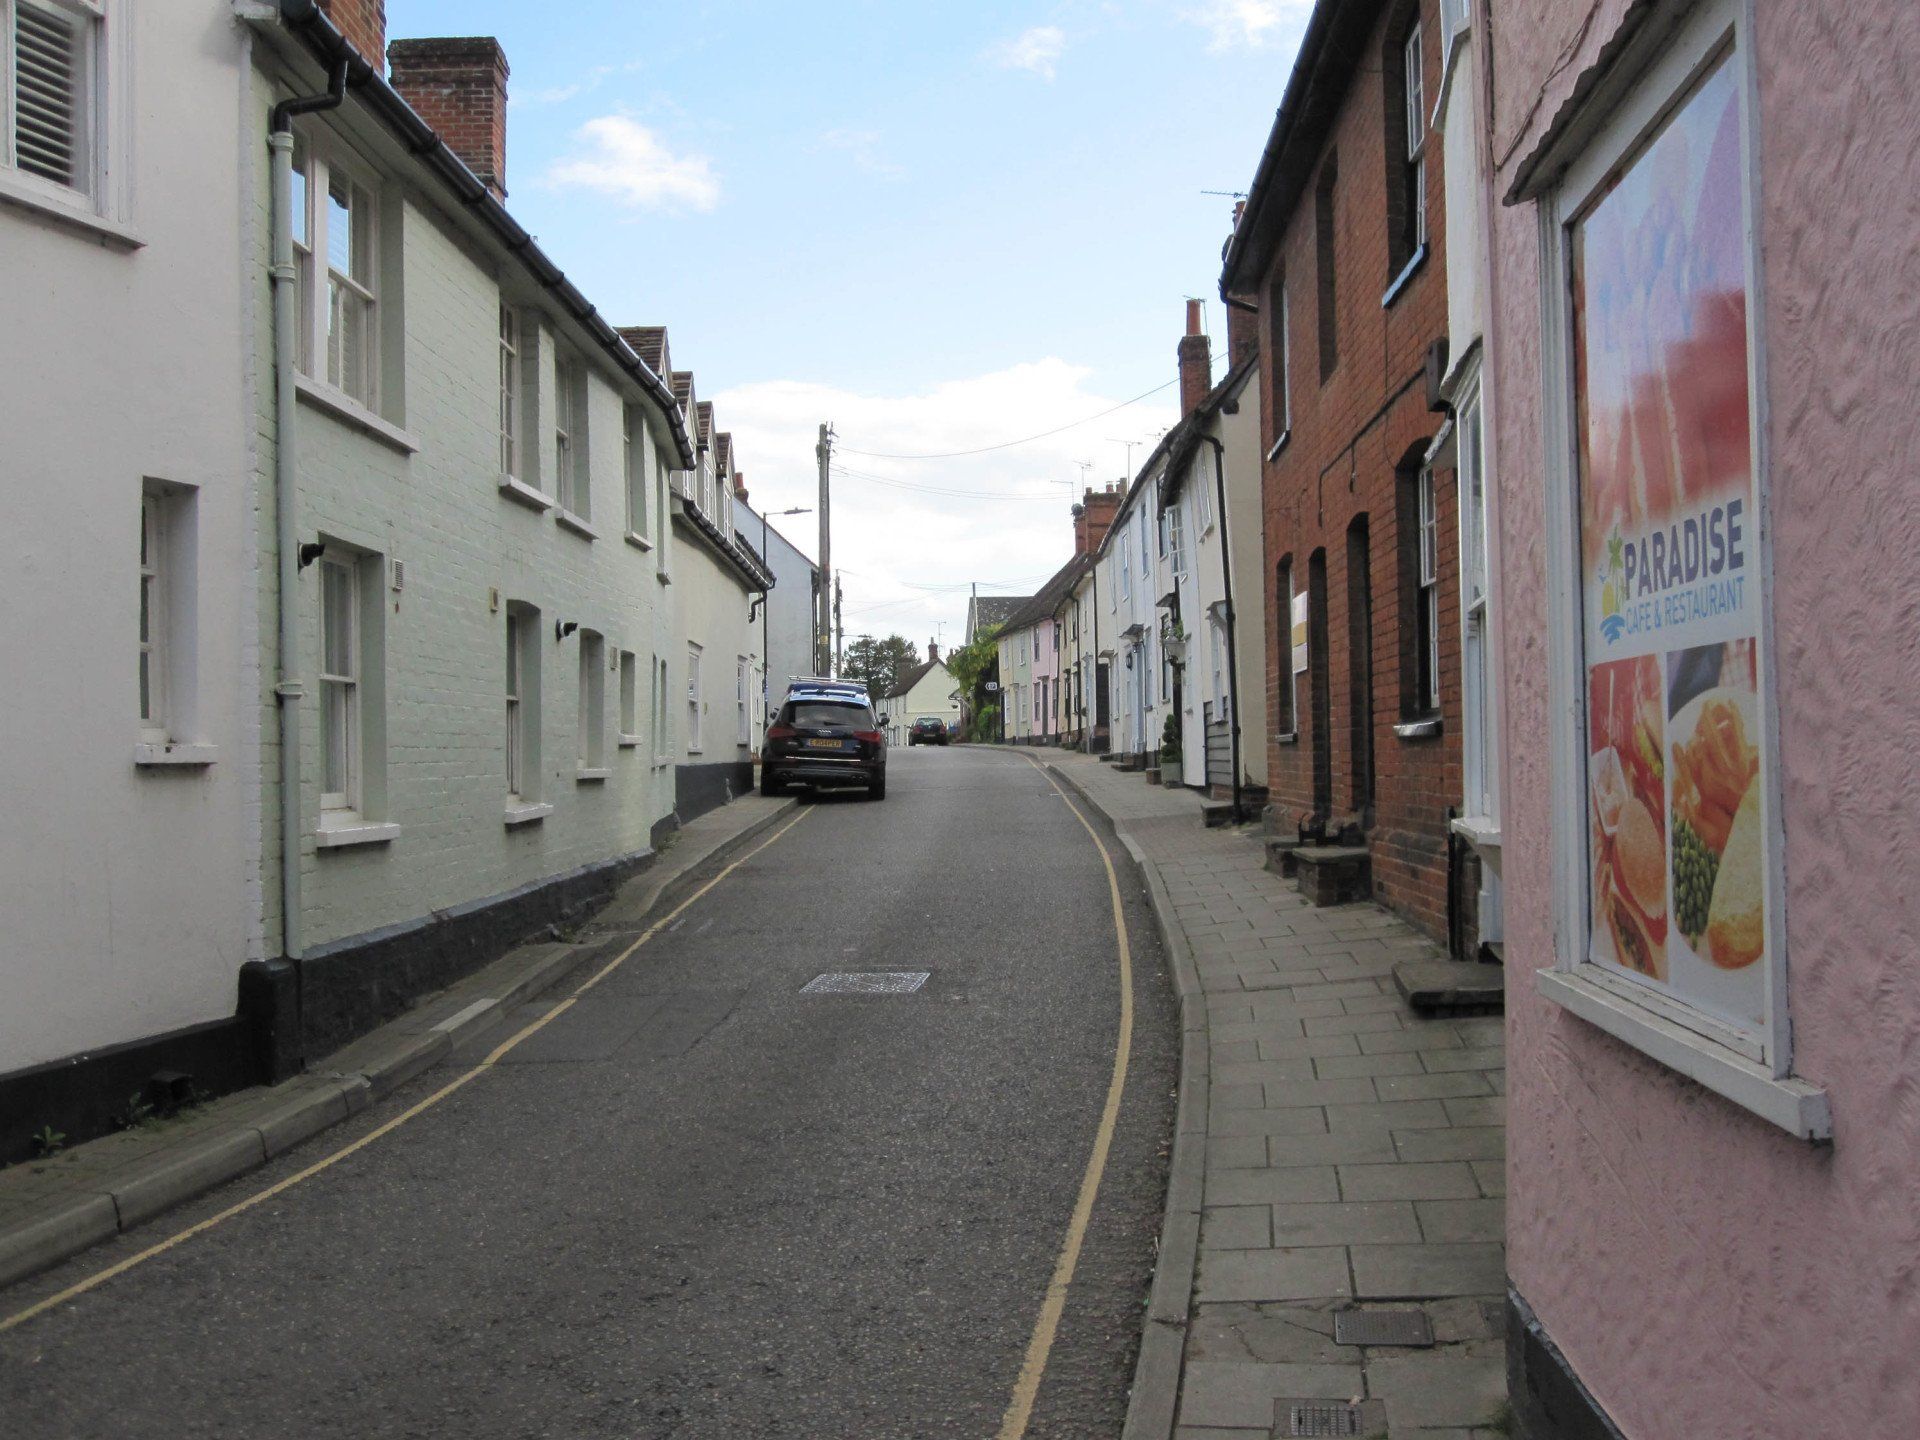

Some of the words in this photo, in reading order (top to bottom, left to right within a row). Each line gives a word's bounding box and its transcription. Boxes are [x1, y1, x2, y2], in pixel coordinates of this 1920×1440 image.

[1624, 498, 1744, 600] PARADISE
[1626, 602, 1651, 635] CAFE
[1654, 600, 1662, 628] &
[1665, 576, 1745, 625] RESTAURANT
